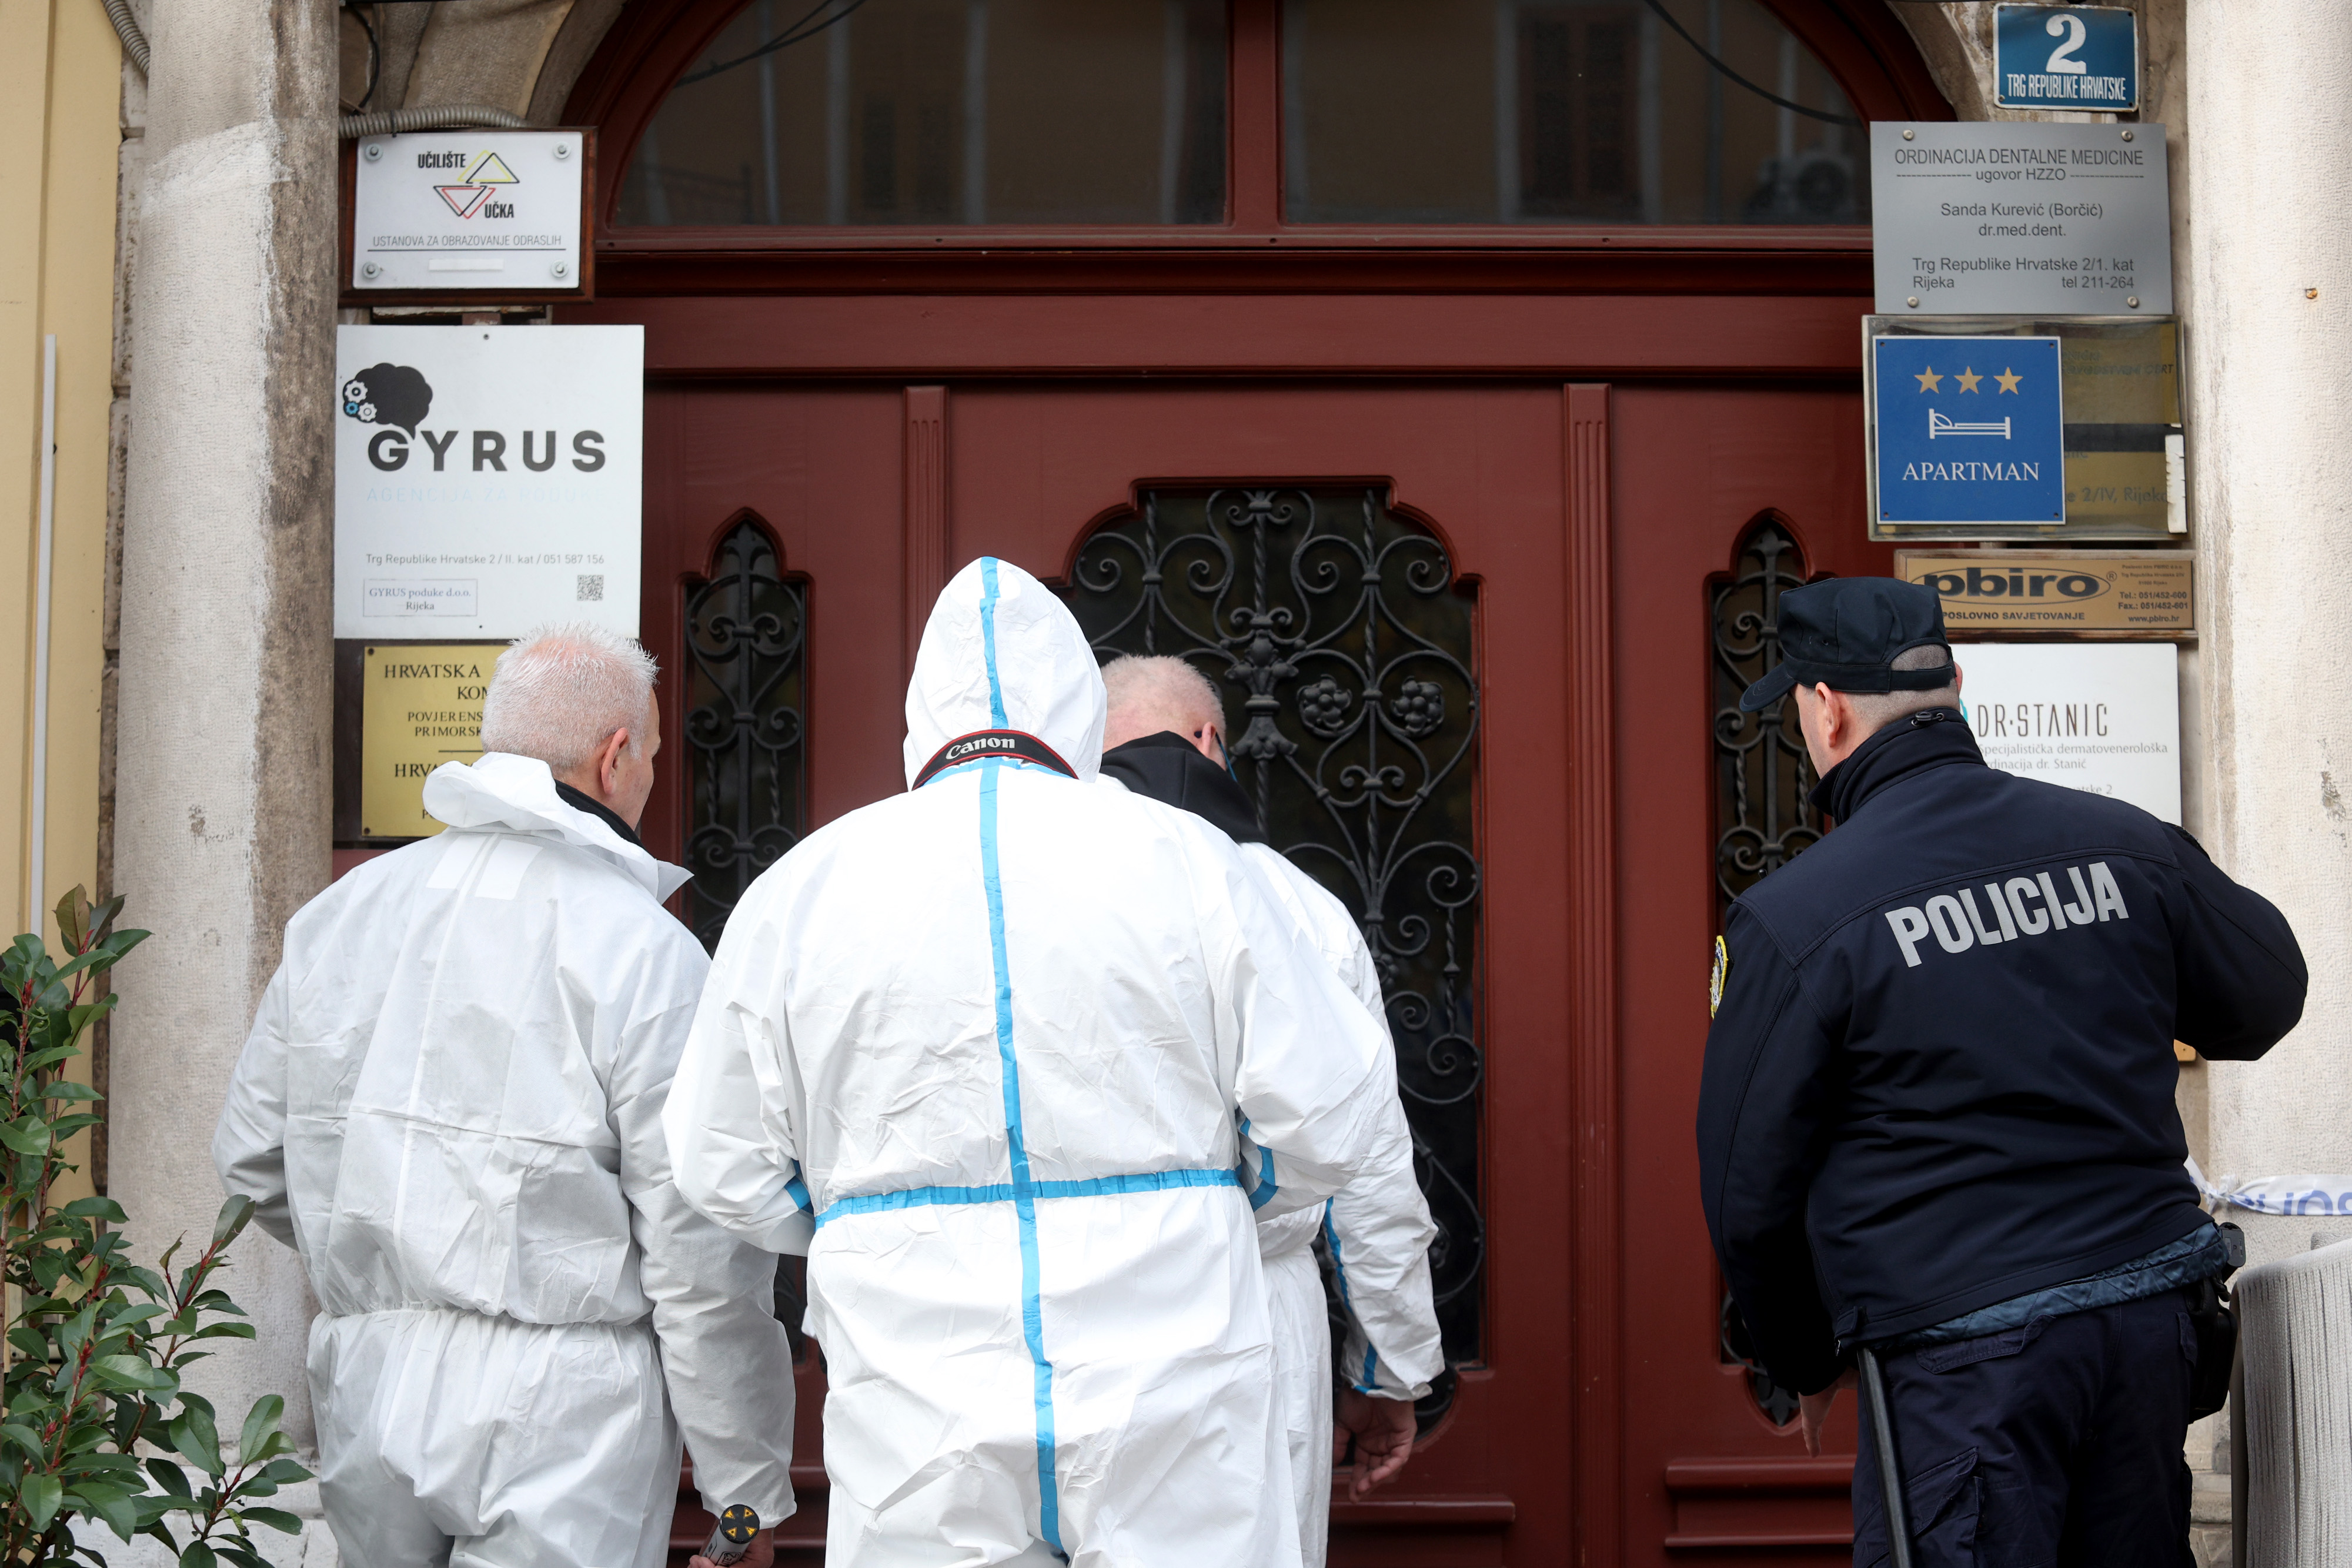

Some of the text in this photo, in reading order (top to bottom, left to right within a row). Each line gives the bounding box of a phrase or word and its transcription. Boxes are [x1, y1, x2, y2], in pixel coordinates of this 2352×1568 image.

[2045, 14, 2087, 75] 2
[2007, 73, 2126, 101] TRG REPUBLIKE HRVATSKE
[417, 151, 466, 169] UČILIŠTE
[1895, 148, 2144, 165] ORDINACIJA DENTALNE MEDICINE
[1976, 168, 2066, 183] ugovor HZZO
[485, 201, 514, 219] UČKA
[1941, 202, 2103, 219] Sanda Kurević (Borčić)
[1979, 223, 2066, 236] dr.med.dent.
[373, 235, 561, 247] USTANOVA ZA OBRAZOVANJE ODRASLIH
[1913, 257, 2134, 273] Trg Republike Hrvatske 2/1. kat
[1913, 276, 2134, 291] Rijeka tel 211-264
[368, 430, 606, 472] GYRUS
[1902, 462, 2040, 481] APARTMAN
[366, 487, 473, 503] AGENCIJA
[483, 487, 508, 502] ZA
[366, 554, 382, 566] Trg
[386, 553, 437, 566] Republike
[440, 554, 486, 564] Hrvatske
[489, 554, 495, 564] 2
[518, 554, 534, 564] kat
[544, 554, 562, 564] 051
[565, 554, 584, 564] 587
[587, 554, 604, 564] 156
[1925, 567, 2100, 597] pbiro
[369, 587, 471, 600] GYRUS poduke d.o.o.
[406, 601, 435, 612] Rijeka
[1943, 611, 2085, 620] POSLOVNO SAVJETOVANJE
[384, 664, 481, 678] HRVATSKA
[408, 711, 483, 722] POVJERENS
[415, 726, 482, 737] PRIMORSK
[946, 737, 1015, 760] Canon
[1979, 743, 2168, 757] Specijalistička dermatovenerološka
[1987, 758, 2087, 772] rdinacija dr. Stanić
[2106, 784, 2112, 794] 2
[1885, 861, 2129, 968] POLICIJA
